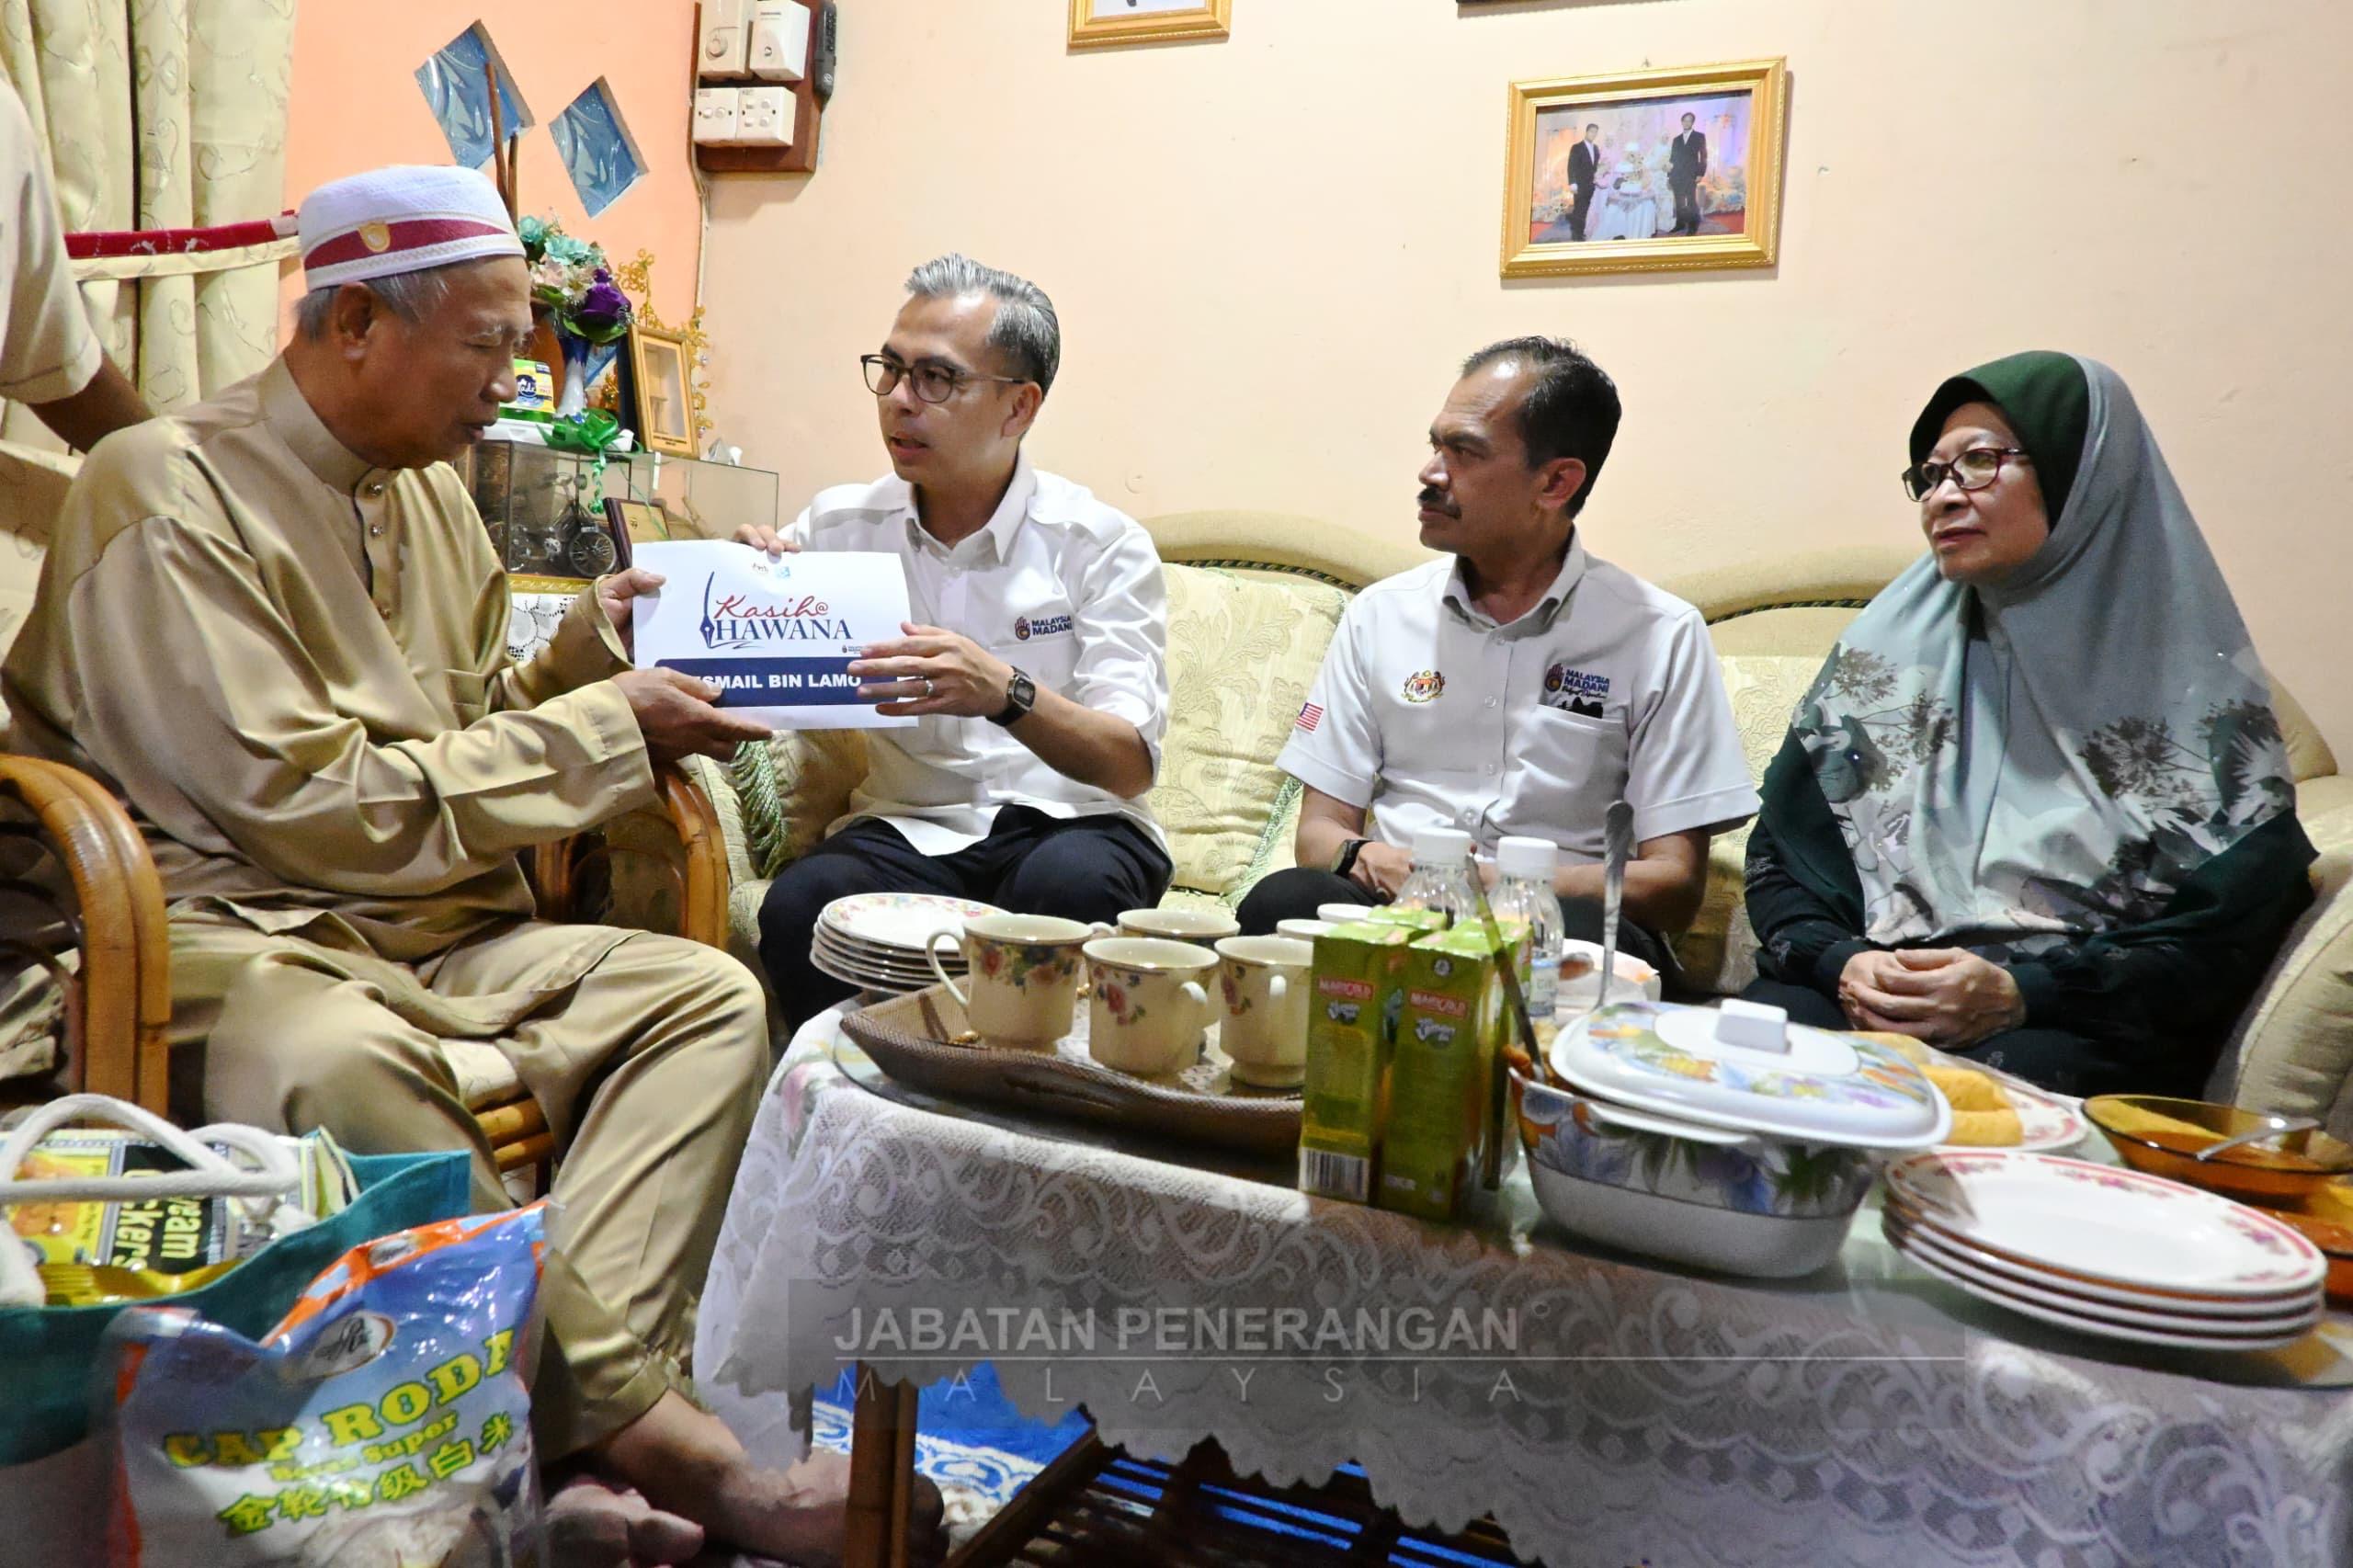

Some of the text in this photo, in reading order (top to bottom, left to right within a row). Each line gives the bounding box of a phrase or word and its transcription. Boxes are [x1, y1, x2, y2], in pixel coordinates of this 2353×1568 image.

[713, 595, 829, 619] Kasih@
[716, 618, 853, 641] HAWANA
[1031, 615, 1071, 627] MALAYSIA
[1032, 622, 1073, 636] MADANI
[691, 675, 763, 689] SMAIL
[768, 674, 802, 688] BIN
[1563, 676, 1609, 693] MADANI
[1565, 668, 1609, 684] MALAYSIA
[111, 1169, 163, 1271] Cckers
[160, 1195, 202, 1259] ream
[361, 1410, 459, 1465] Super
